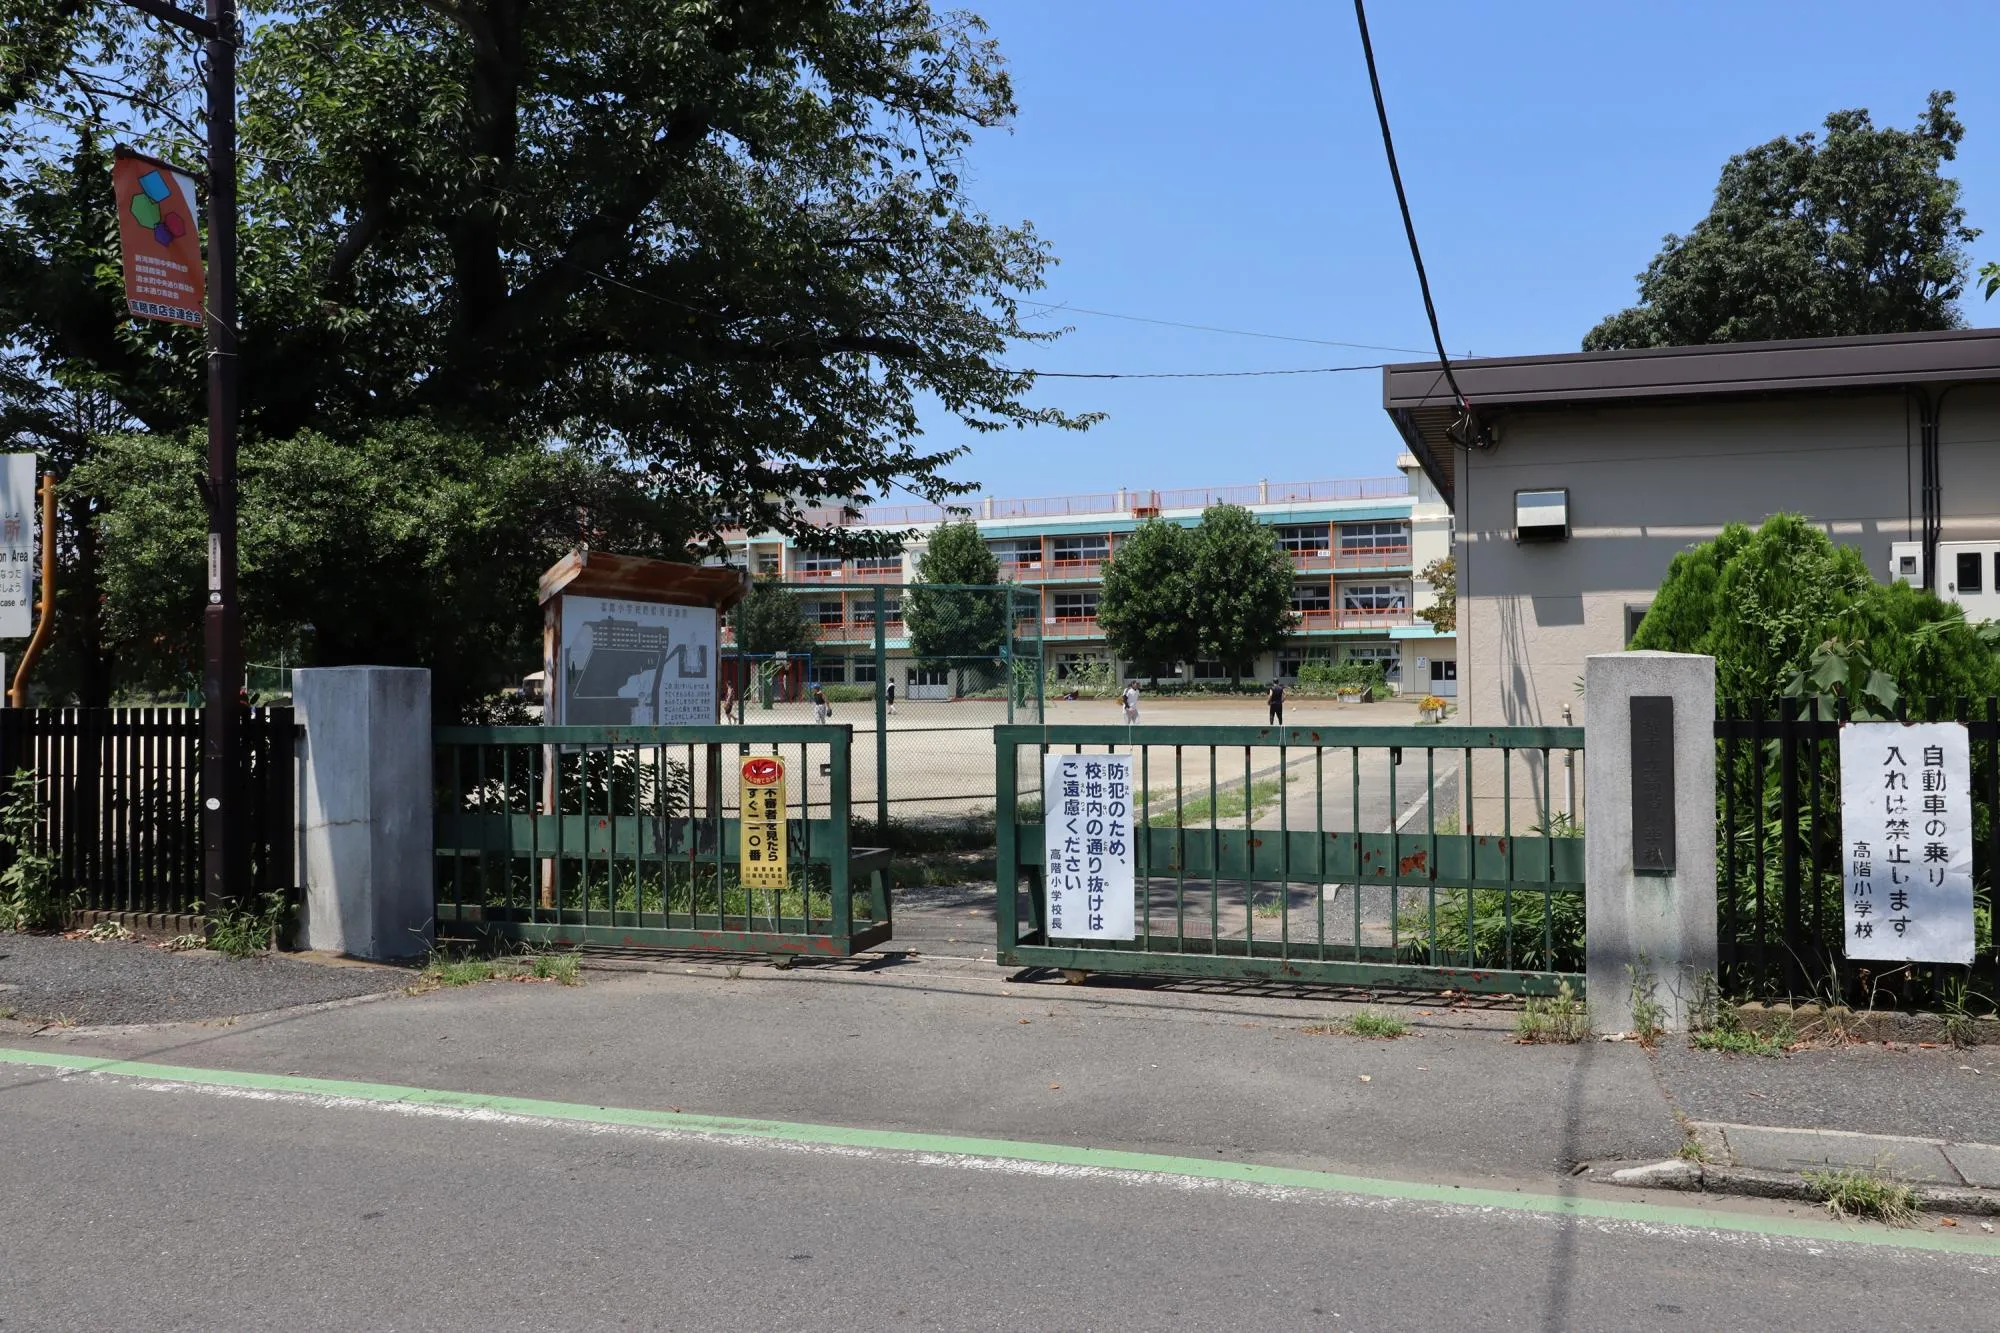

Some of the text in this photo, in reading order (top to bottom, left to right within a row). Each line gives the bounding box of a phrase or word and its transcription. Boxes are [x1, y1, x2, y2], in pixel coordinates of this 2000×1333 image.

[11, 549, 28, 563] Area
[19, 597, 27, 607] of
[764, 788, 778, 861] 不審者を見たら
[1063, 762, 1082, 891] ご遠慮ください
[1085, 763, 1104, 931] 校地内の通り抜けは
[1108, 763, 1126, 865] 防犯のため、
[1883, 746, 1912, 938] 入れは禁止します
[1921, 744, 1949, 888] 自動車の乗り
[1050, 848, 1063, 930] 高階小学校長
[1853, 841, 1873, 939] 高階小学校
